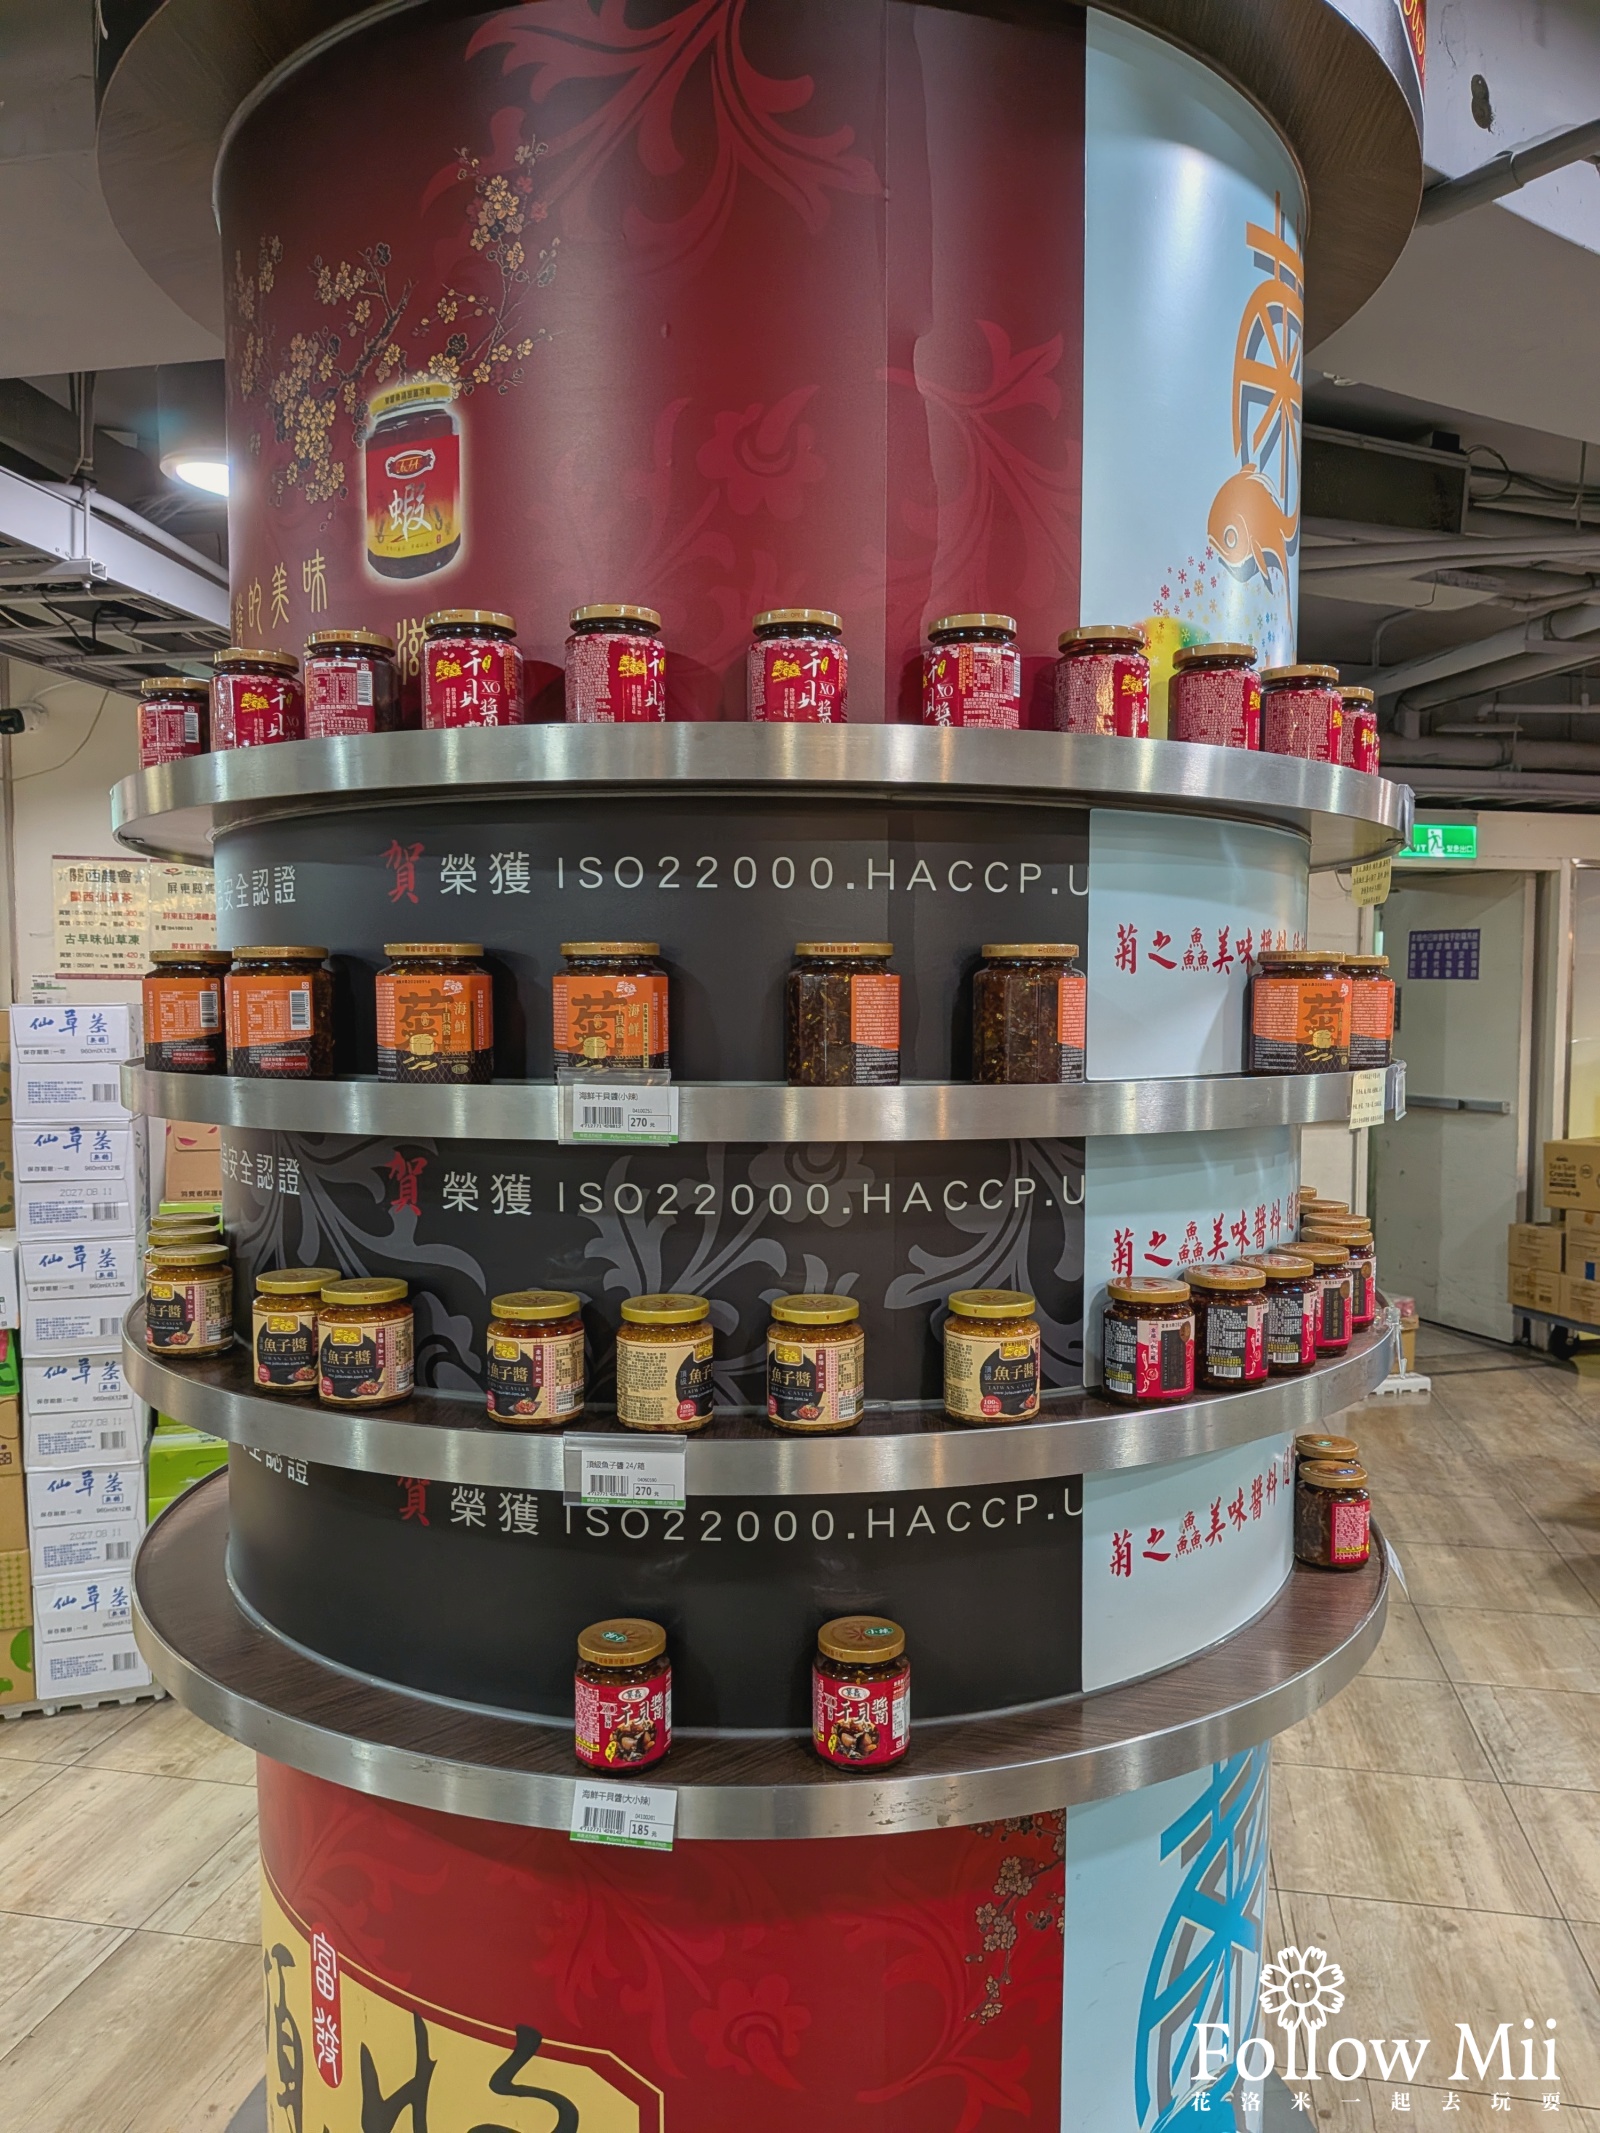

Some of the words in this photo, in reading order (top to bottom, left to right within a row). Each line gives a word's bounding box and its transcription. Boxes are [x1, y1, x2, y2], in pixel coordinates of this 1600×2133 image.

[389, 483, 432, 542] 蝦
[460, 650, 482, 708] 干貝
[482, 681, 501, 694] XO
[798, 651, 822, 708] 干貝
[820, 682, 835, 696] XO
[938, 684, 954, 698] XO
[380, 839, 425, 904] 賀
[440, 851, 531, 895] 榮獲
[65, 933, 140, 945] 古早味仙草凍
[29, 1008, 108, 1037] 仙草茶
[454, 1001, 468, 1035] 海鮮
[628, 1003, 641, 1038] 海鮮
[579, 1091, 638, 1101] 海鮮干貝醬(小辣)
[630, 1117, 647, 1127] 270
[34, 1126, 112, 1154] 仙草茶
[385, 1150, 428, 1217] 賀
[442, 1171, 532, 1216] 榮獲
[557, 1173, 1086, 1217] ISO22000.HACCP.U
[39, 1244, 117, 1272] 仙草茶
[263, 1337, 308, 1353] 魚子醬
[327, 1349, 372, 1366] 魚子醬
[43, 1357, 121, 1385] 仙草茶
[490, 1366, 528, 1383] 魚子醬
[688, 1363, 713, 1384] 魚子
[771, 1366, 812, 1388] 魚子醬
[993, 1362, 1034, 1381] 魚子醬
[586, 1461, 624, 1470] 頂級魚子醬
[626, 1462, 645, 1470] 24/箱
[47, 1470, 124, 1498] 仙草茶
[635, 1486, 651, 1496] 270
[450, 1486, 539, 1536] 榮獲
[53, 1585, 130, 1612] 仙草茶
[614, 1692, 664, 1728] 干貝醬
[834, 1696, 889, 1725] 干貝醬
[582, 1789, 651, 1806] 海鮮干貝醬(大小辣)
[631, 1824, 649, 1836] 185
